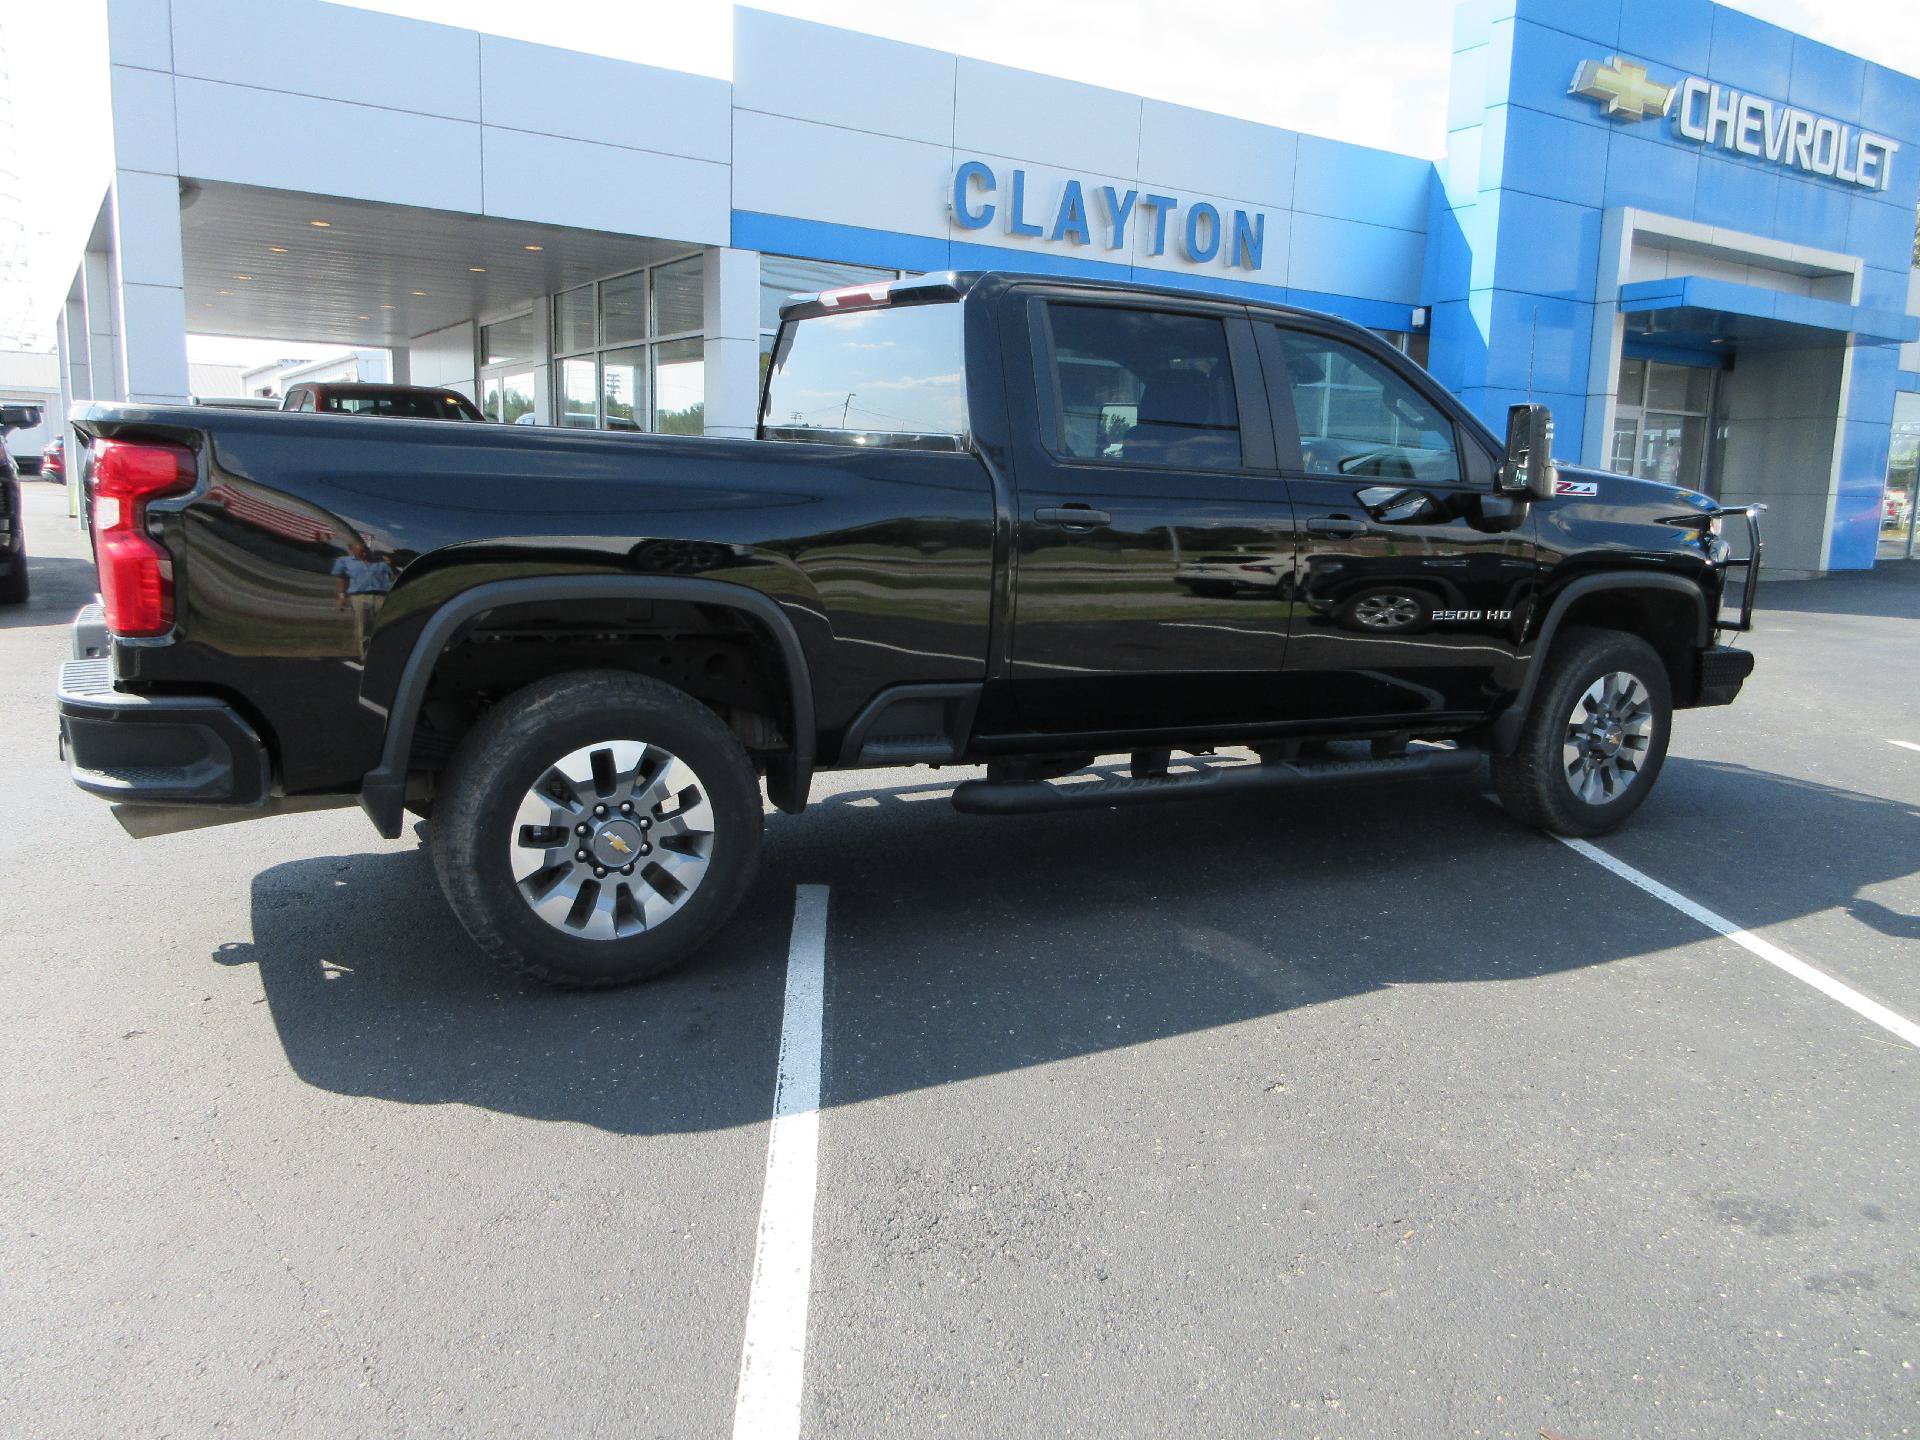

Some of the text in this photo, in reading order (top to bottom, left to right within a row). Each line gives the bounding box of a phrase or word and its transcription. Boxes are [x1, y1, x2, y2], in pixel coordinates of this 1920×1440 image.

[1677, 76, 1899, 191] CHEVROLET
[952, 160, 1266, 271] CLAYTON
[1432, 610, 1512, 620] 2500 HD
